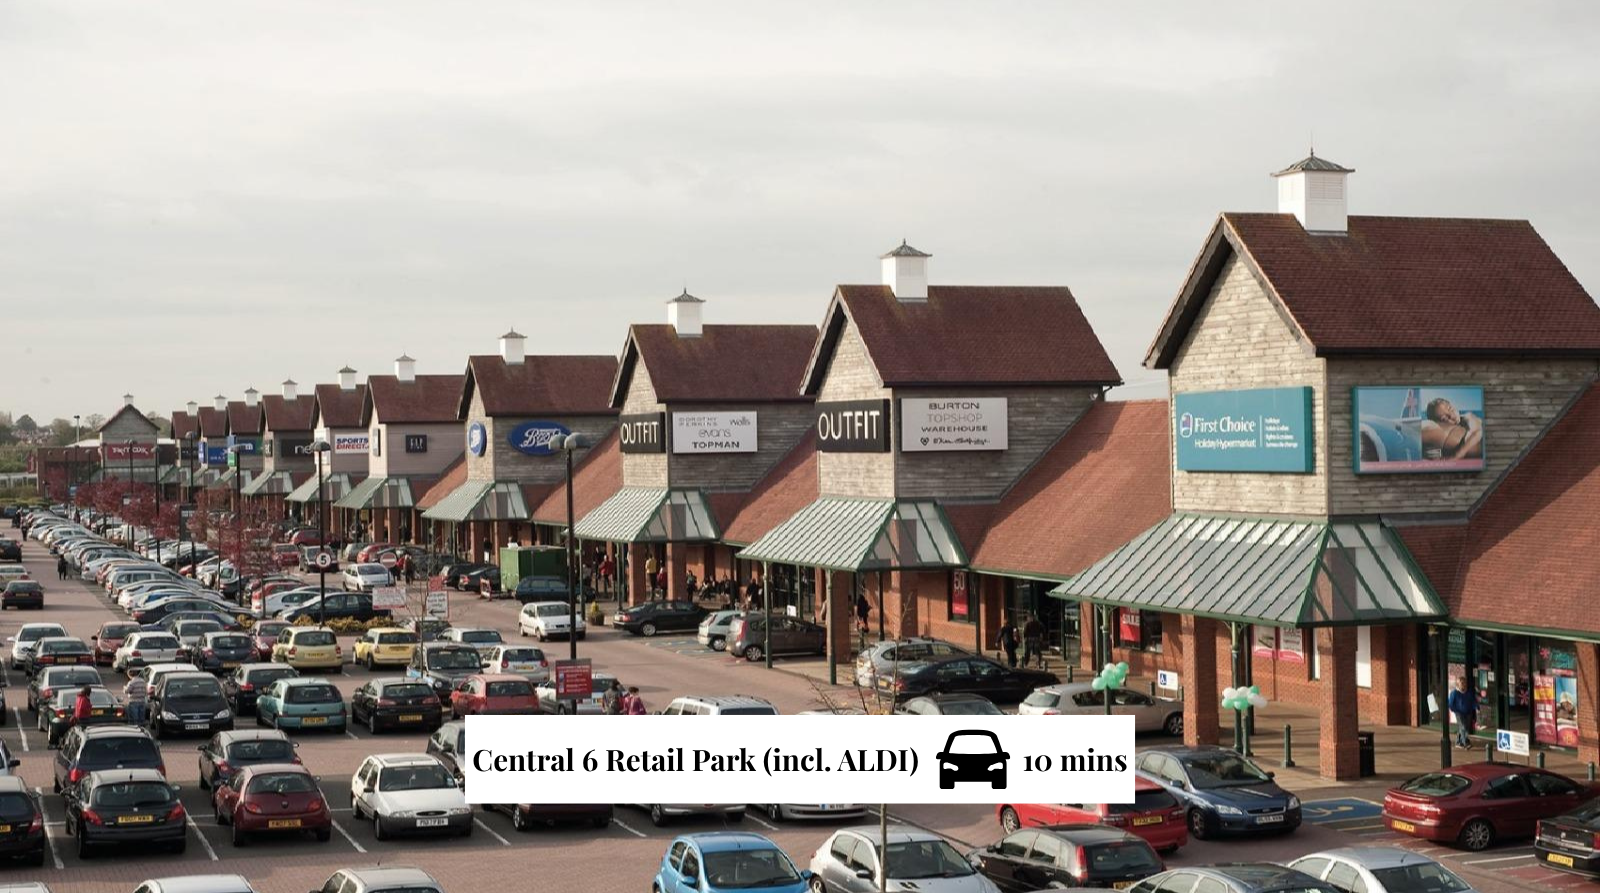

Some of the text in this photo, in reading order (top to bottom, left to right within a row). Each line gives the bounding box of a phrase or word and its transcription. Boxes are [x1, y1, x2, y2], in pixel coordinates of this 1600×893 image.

[928, 402, 980, 410] BURTON
[927, 412, 983, 423] TOPSHOP
[818, 410, 880, 440] OUTFIT
[1194, 415, 1256, 433] First Choice
[621, 422, 660, 444] OUTFIT
[698, 428, 731, 437] evans
[691, 441, 740, 449] TOPMAN
[1194, 438, 1257, 450] Holiday Hypermarket
[319, 555, 327, 565] 5
[953, 573, 966, 590] 50
[1122, 613, 1141, 627] SALE
